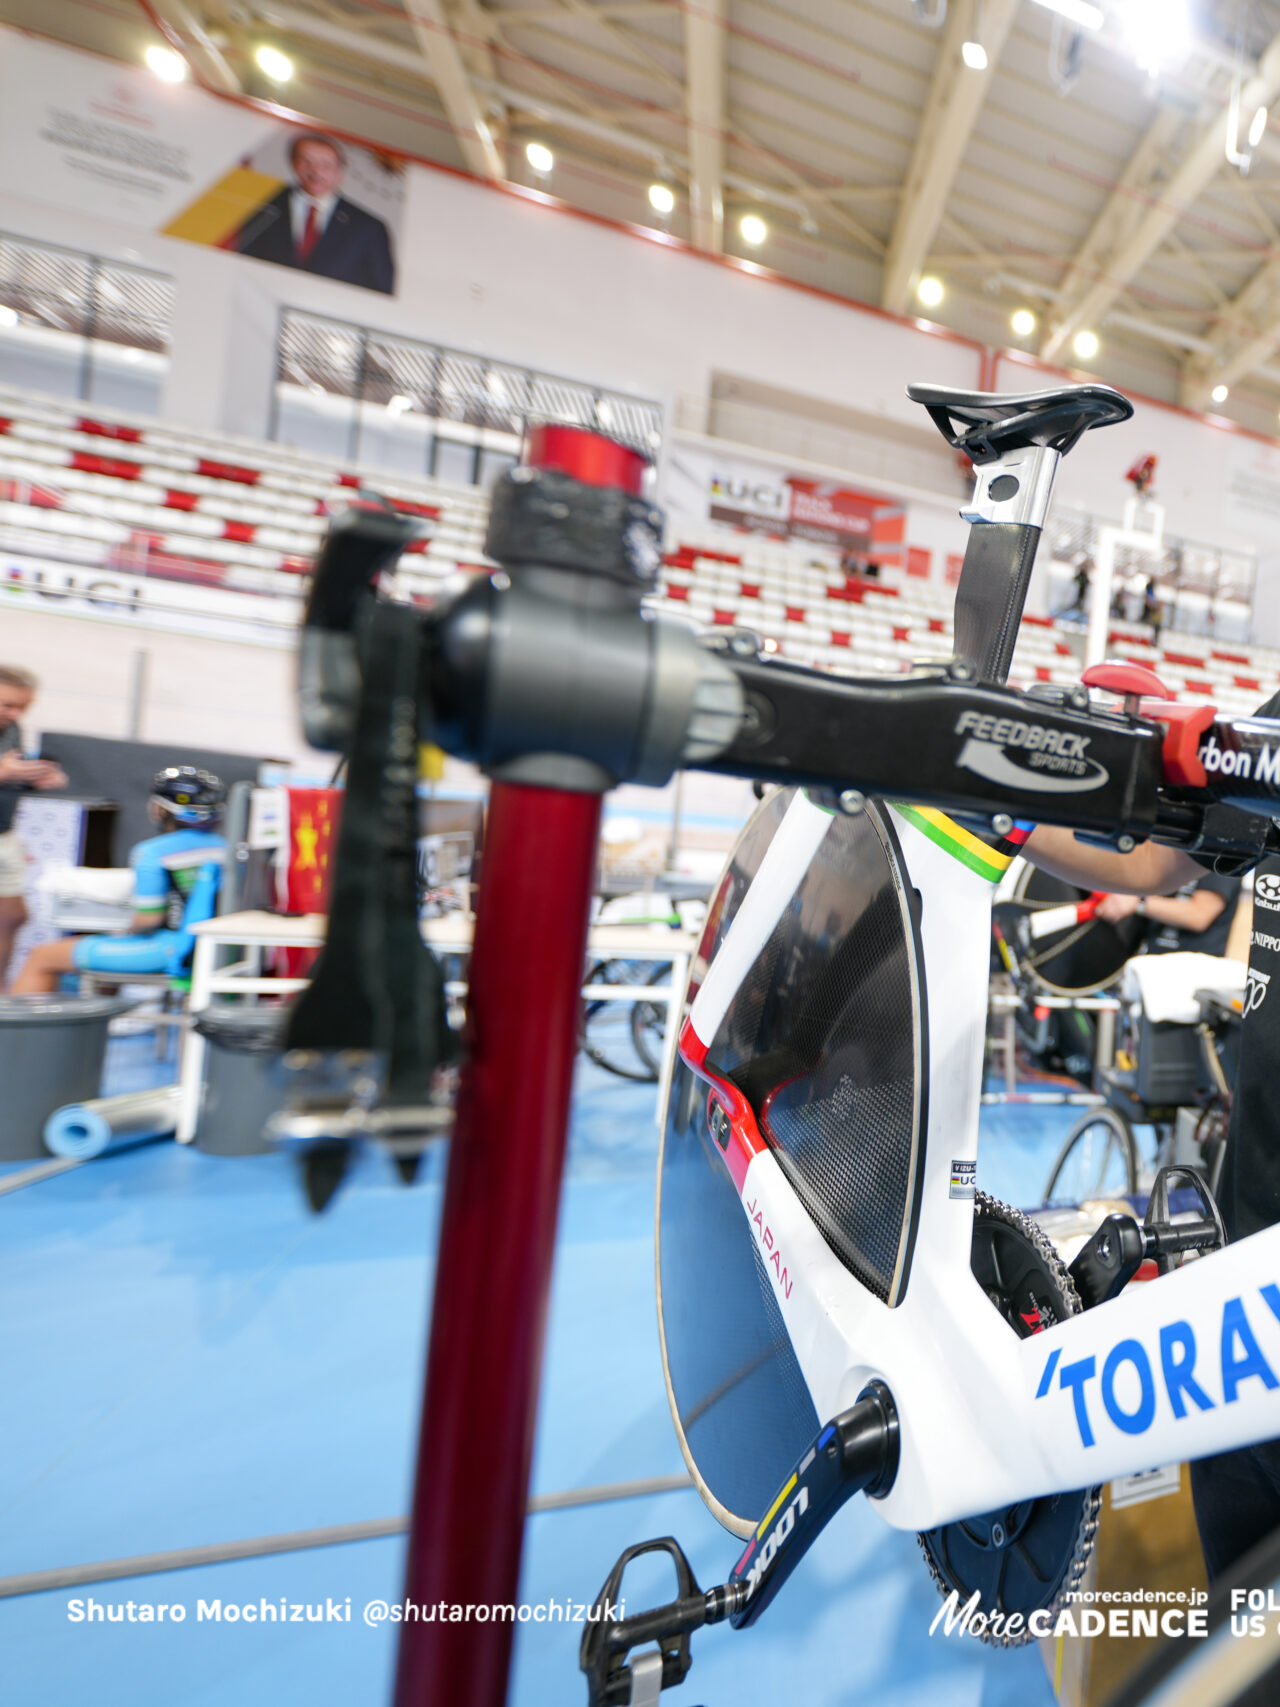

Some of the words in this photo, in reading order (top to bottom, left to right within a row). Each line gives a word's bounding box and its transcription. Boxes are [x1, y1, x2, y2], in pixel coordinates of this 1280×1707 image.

[727, 479, 783, 508] UCI
[954, 710, 1092, 759] FEEDBACK
[1029, 751, 1087, 775] SPORTS
[746, 1198, 793, 1300] JAPAN
[745, 1485, 809, 1602] LOOK
